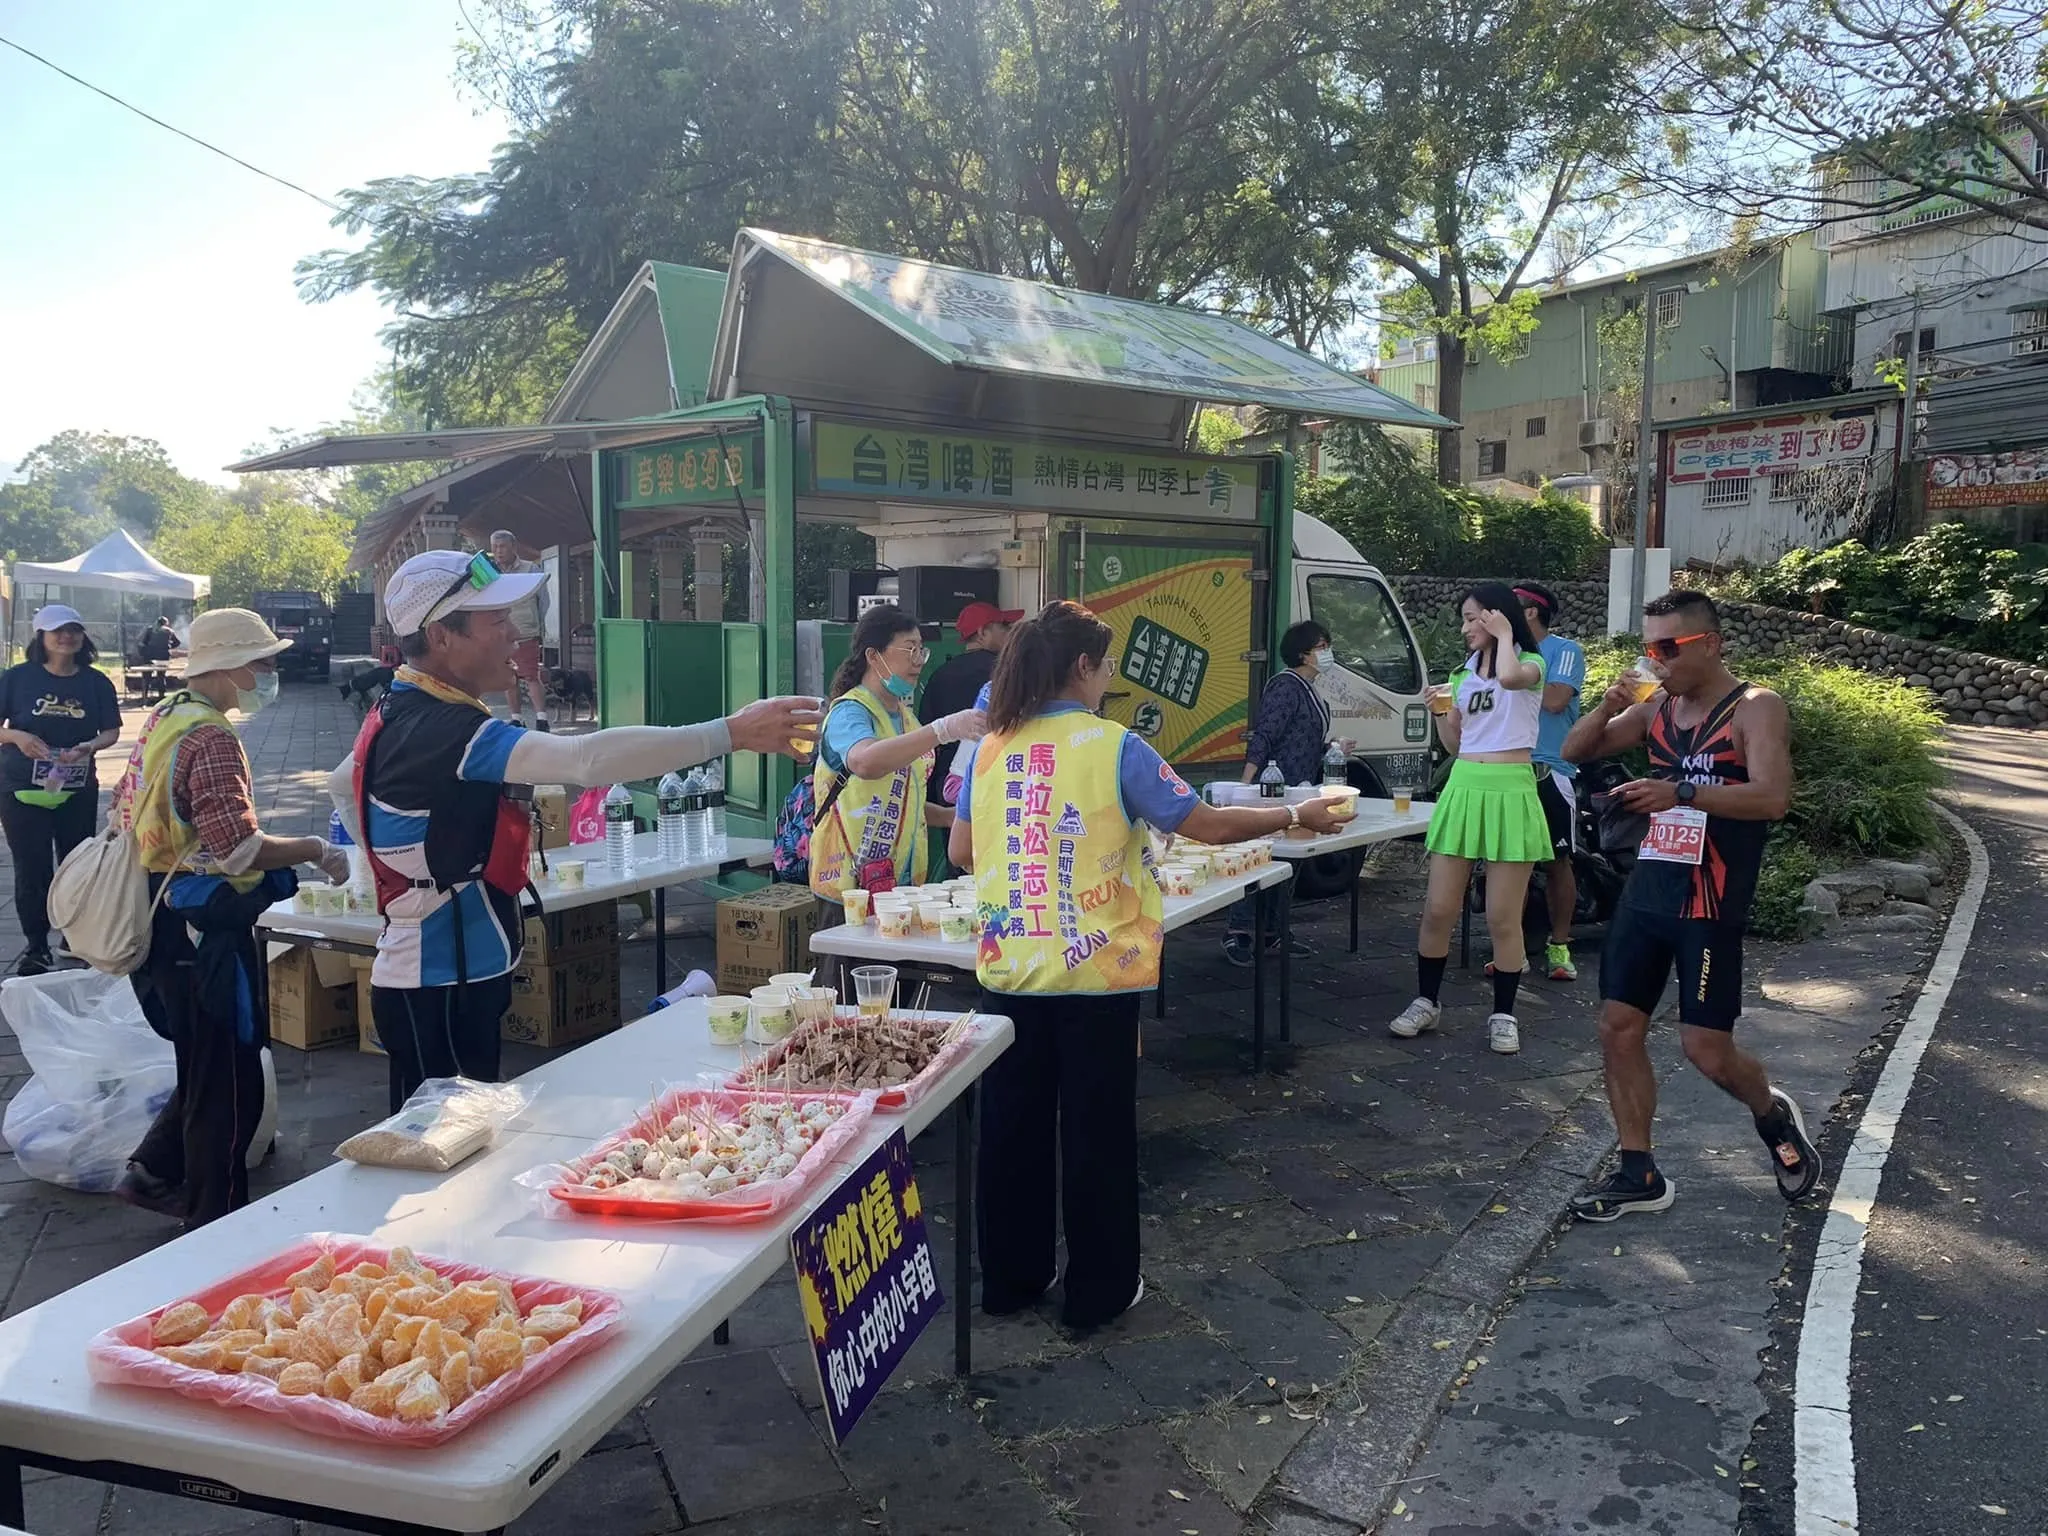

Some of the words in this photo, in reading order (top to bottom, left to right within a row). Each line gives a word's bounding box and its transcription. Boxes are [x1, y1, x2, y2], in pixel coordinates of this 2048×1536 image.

[1704, 449, 1774, 468] 杏仁茶
[1034, 454, 1126, 494] 熱情台灣
[1136, 464, 1239, 514] 四季上青
[1146, 593, 1189, 611] TAIWAN
[1189, 606, 1212, 643] BEER
[1158, 761, 1192, 796] 3
[1005, 753, 1025, 937] 很高興為您服務
[1023, 743, 1056, 938] 馬拉松志工
[1058, 839, 1075, 889] 貝斯特
[818, 868, 841, 882] RUN
[1061, 929, 1110, 971] RUN
[822, 1168, 903, 1316] 燃燒
[826, 1242, 937, 1417] 你心中的小宇宙
[186, 1482, 232, 1500] LIFETIME
